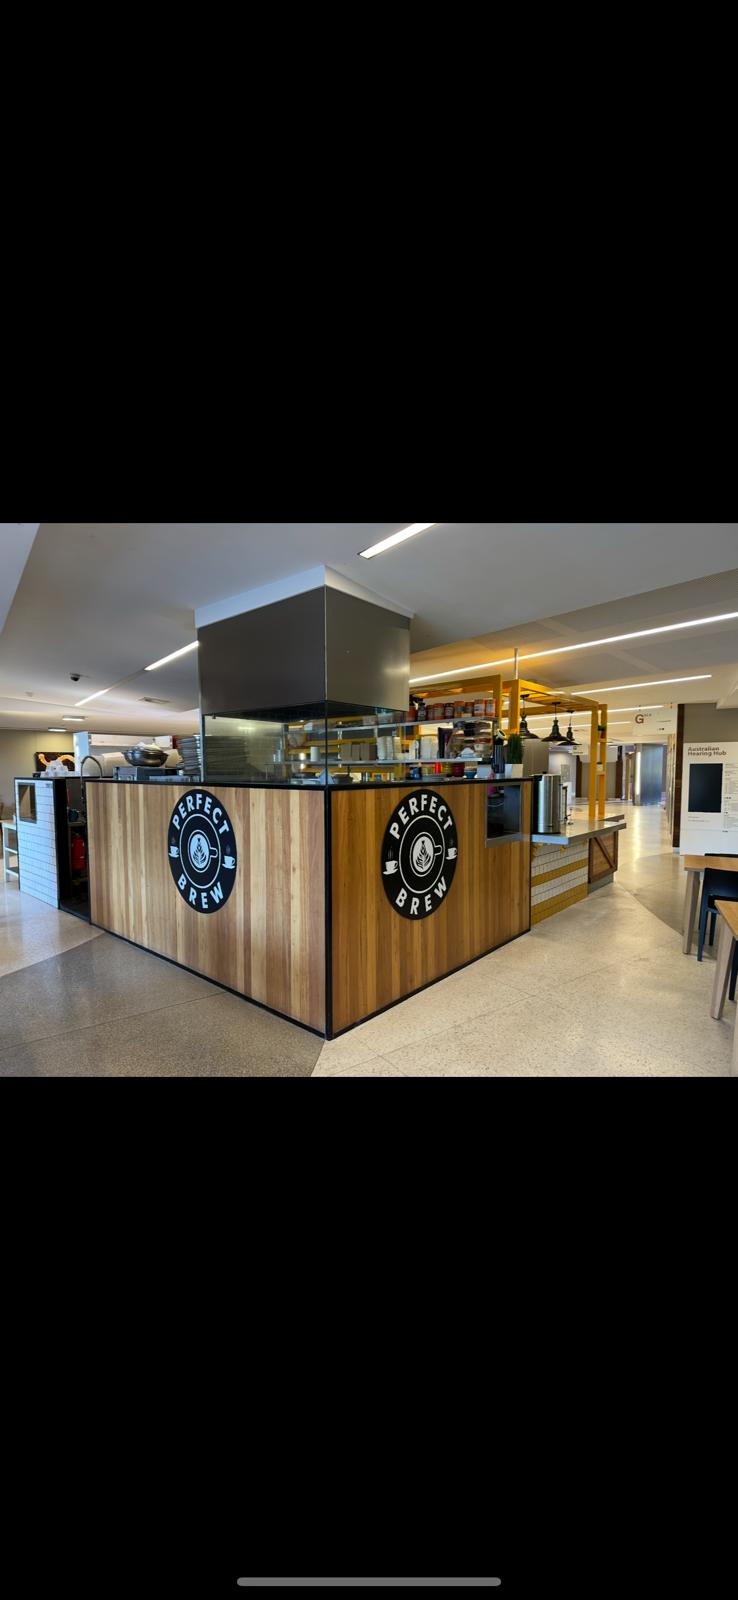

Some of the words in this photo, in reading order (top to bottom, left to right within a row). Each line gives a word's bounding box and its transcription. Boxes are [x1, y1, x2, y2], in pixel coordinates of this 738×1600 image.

[635, 714, 644, 724] G
[172, 793, 230, 835] PERFECT
[389, 794, 453, 840] PERFECT
[177, 873, 224, 909] BREW
[395, 876, 447, 915] BREW
